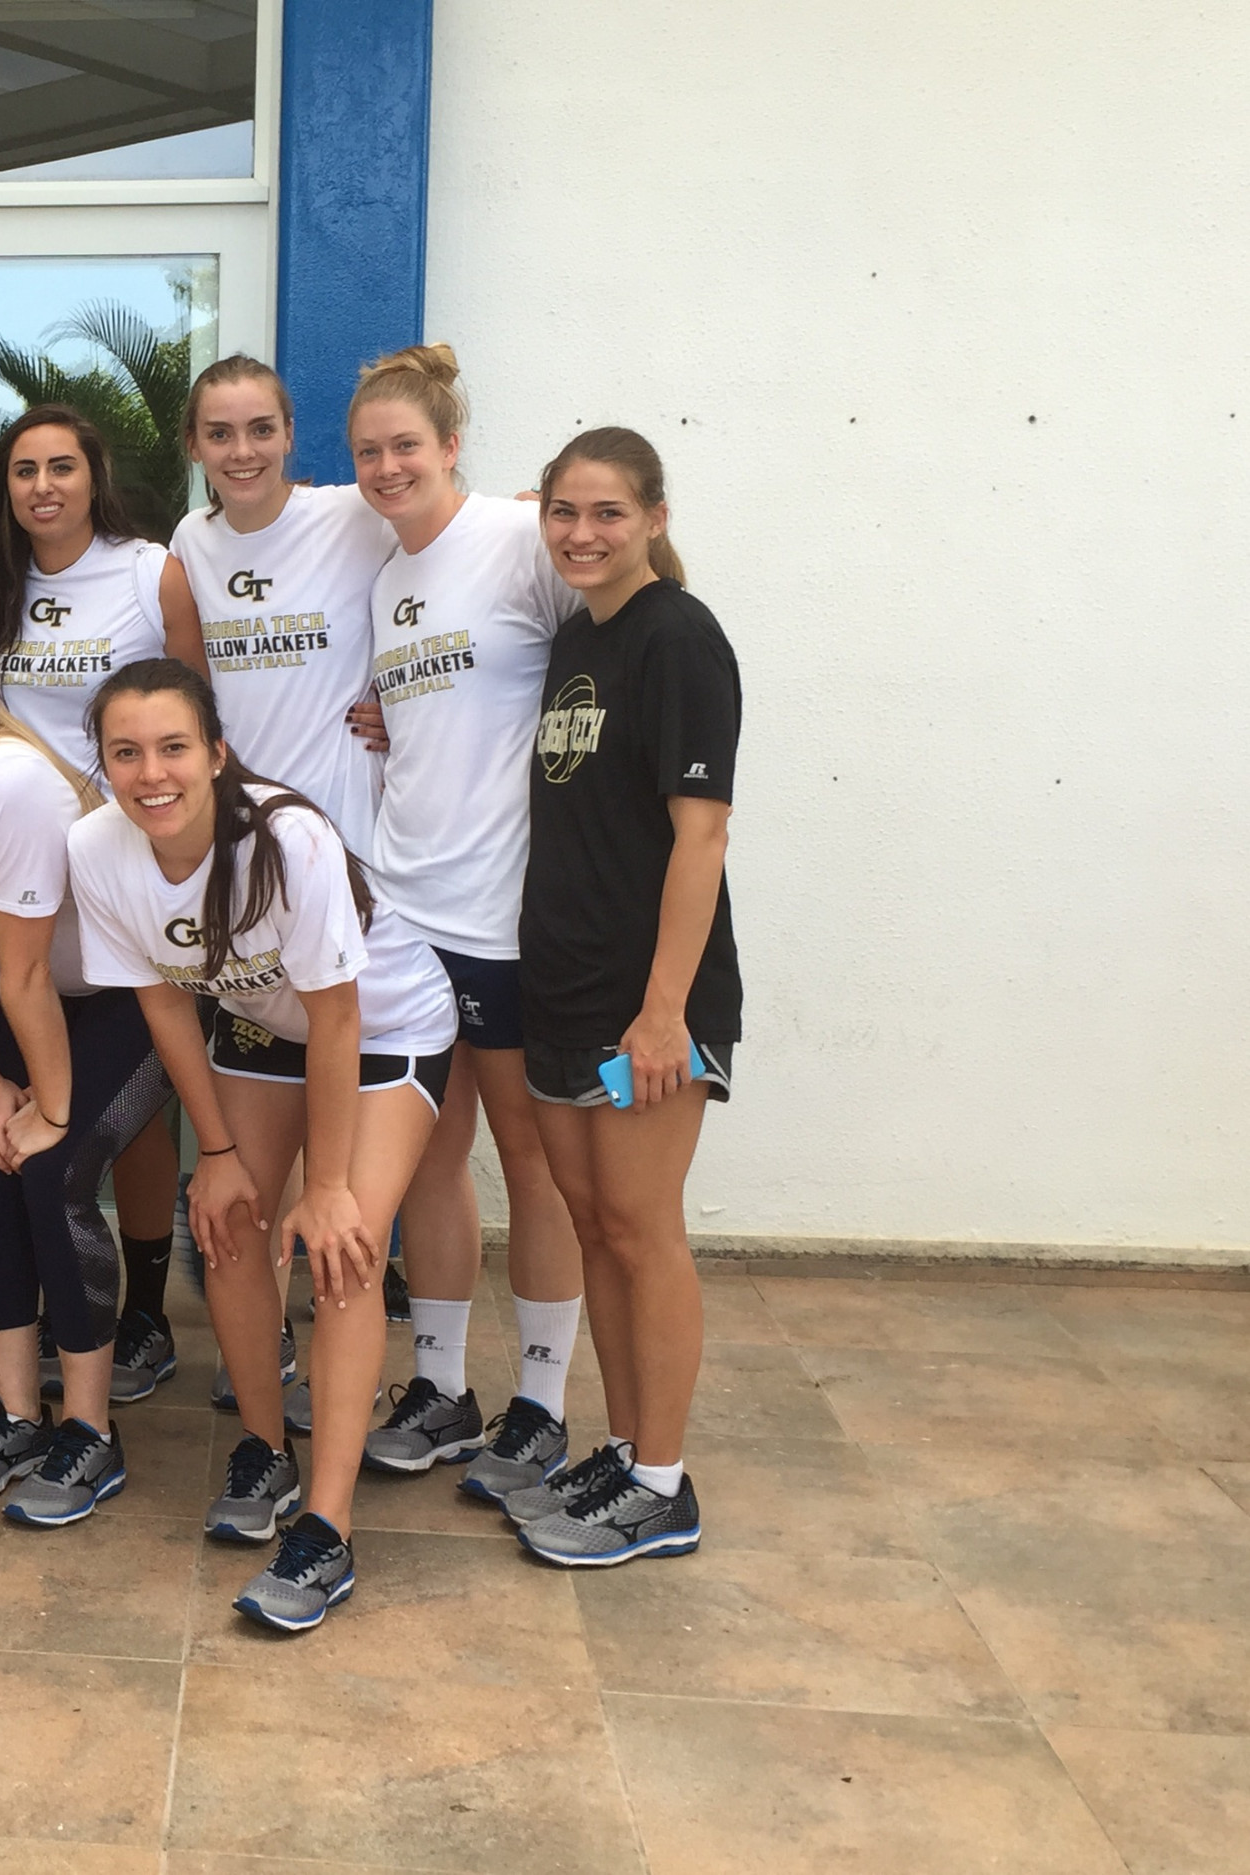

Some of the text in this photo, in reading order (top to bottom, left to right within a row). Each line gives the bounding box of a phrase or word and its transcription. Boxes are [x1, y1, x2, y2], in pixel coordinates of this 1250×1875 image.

[228, 570, 273, 602] GT
[30, 597, 72, 628] GT
[393, 595, 426, 628] GT
[202, 617, 268, 641] EORGIA
[206, 632, 328, 659] ELLOW JACKETS
[37, 655, 112, 673] JACKETS
[376, 651, 475, 693] LLOW JACKETS
[214, 966, 283, 992] JACKET
